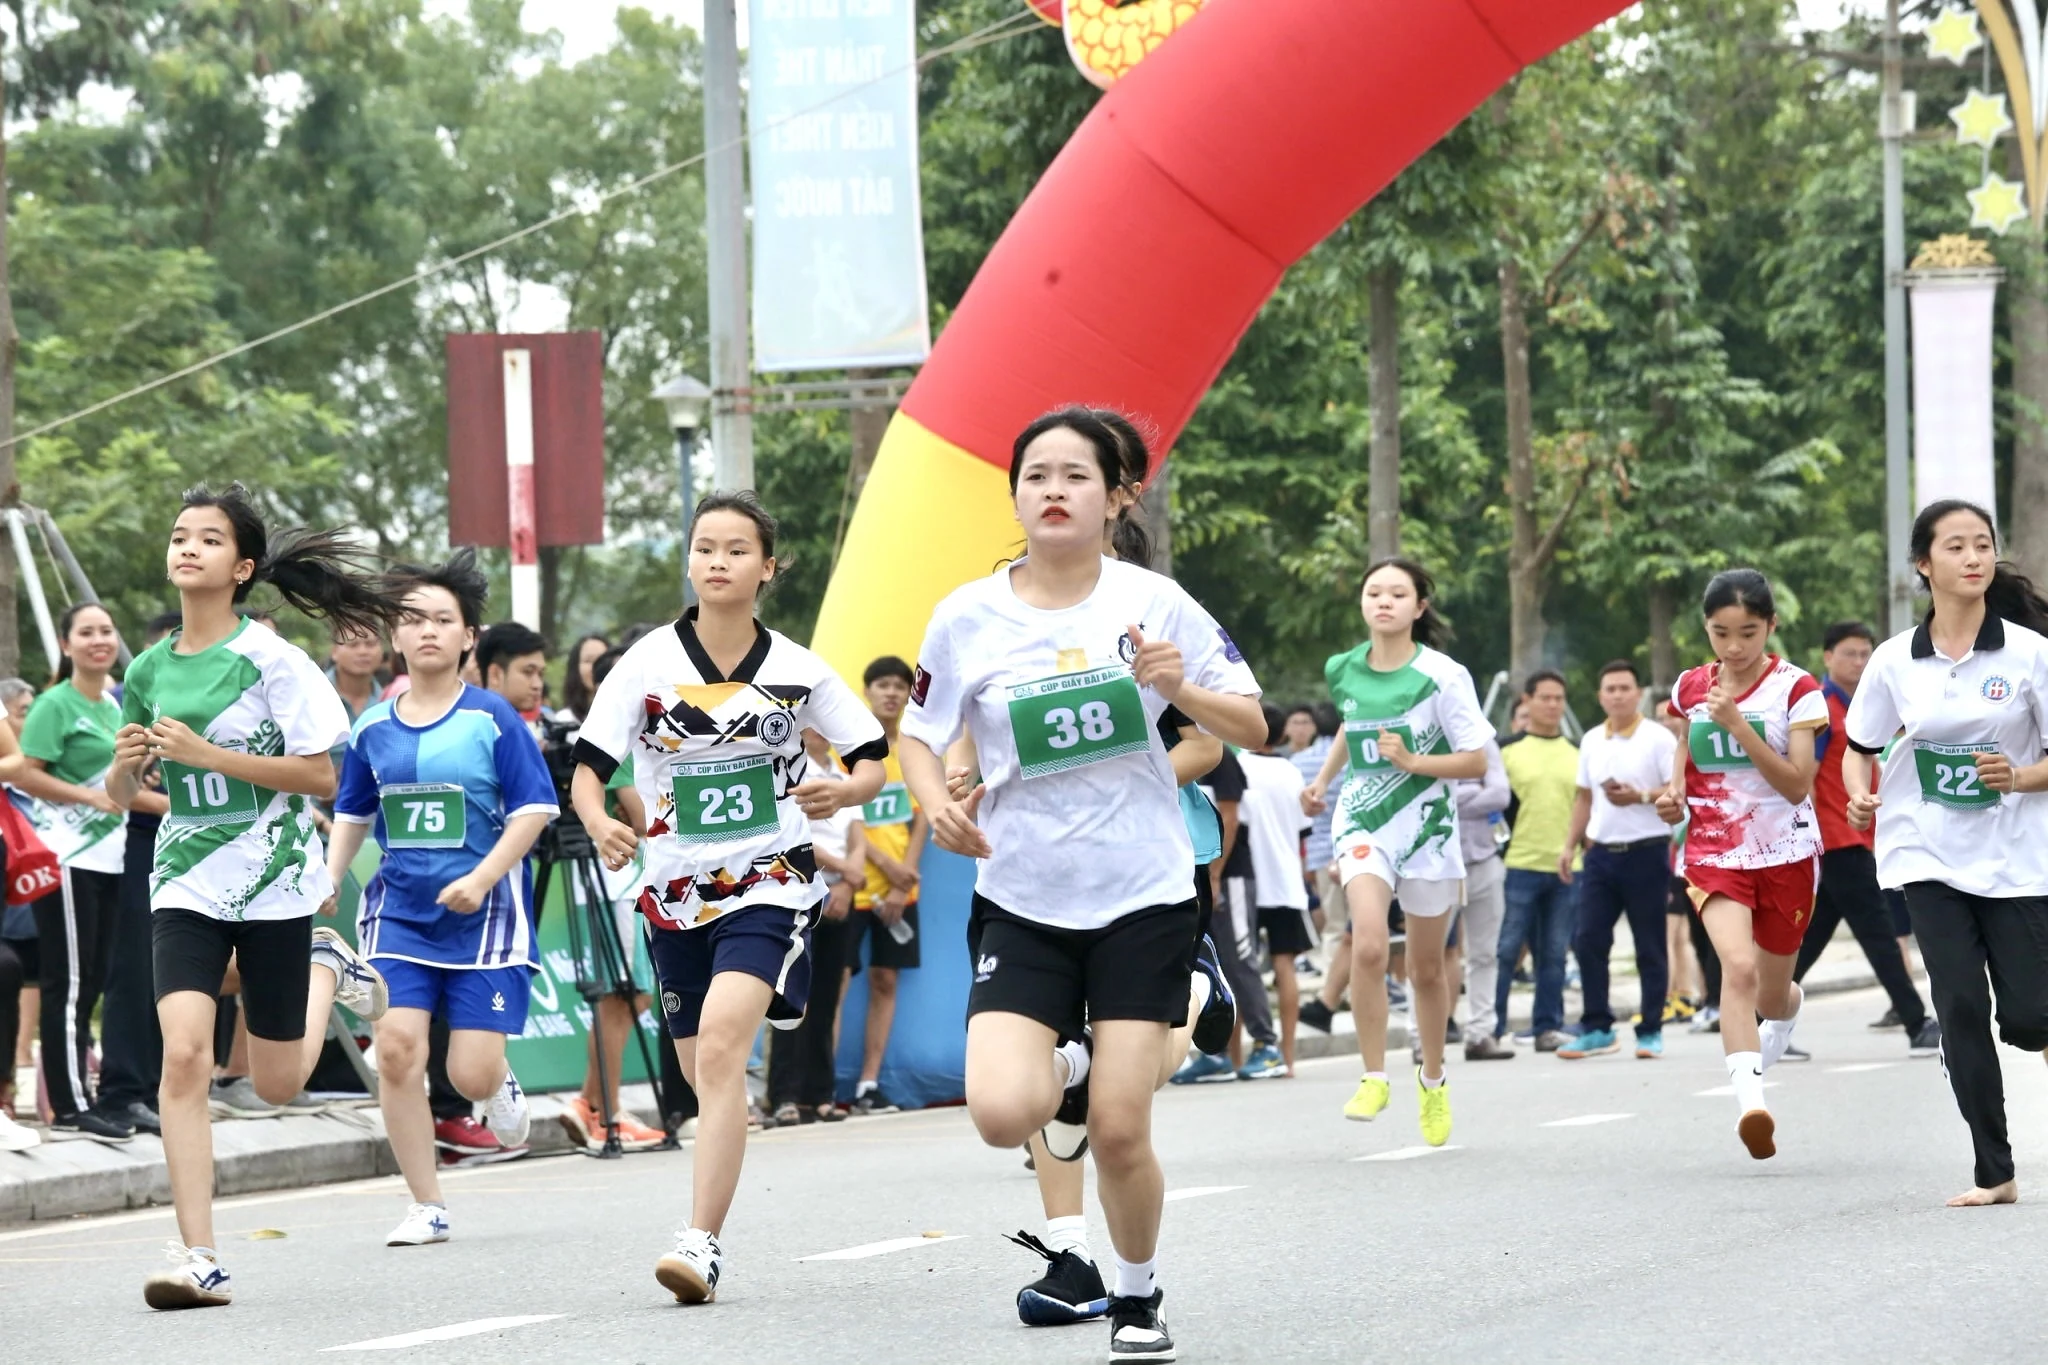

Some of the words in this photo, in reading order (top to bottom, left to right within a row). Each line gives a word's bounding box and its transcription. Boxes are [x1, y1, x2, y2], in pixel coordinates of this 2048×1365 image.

[1044, 700, 1115, 749] 38
[182, 772, 229, 808] 10
[1935, 763, 1980, 796] 22
[402, 801, 446, 832] 75
[699, 784, 754, 825] 23
[872, 794, 897, 818] 77
[15, 866, 57, 895] OK
